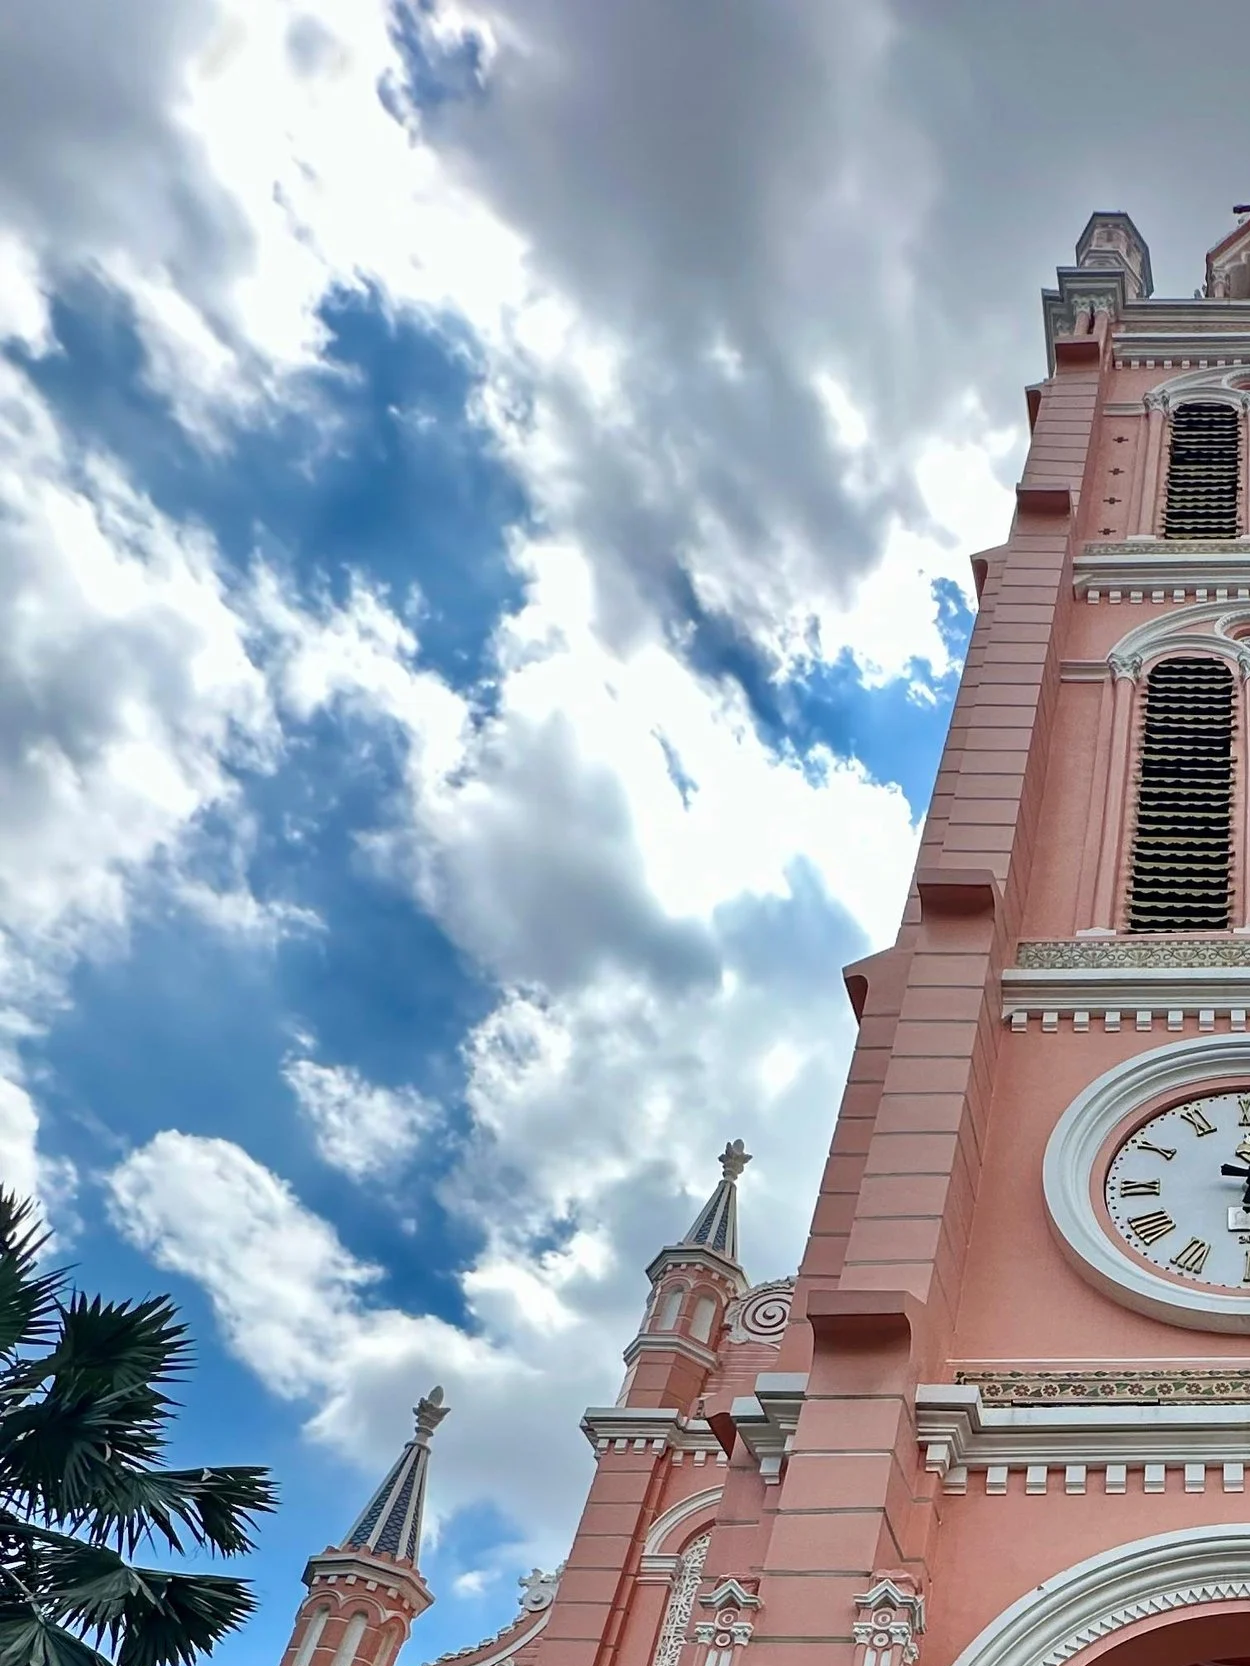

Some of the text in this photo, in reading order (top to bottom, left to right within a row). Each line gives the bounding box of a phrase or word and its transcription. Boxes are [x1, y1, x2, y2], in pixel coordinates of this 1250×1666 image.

[1180, 1108, 1218, 1137] XI
[1136, 1139, 1177, 1161] X
[1120, 1178, 1160, 1198] IX
[1127, 1208, 1176, 1246] VIII
[1169, 1236, 1211, 1274] VII
